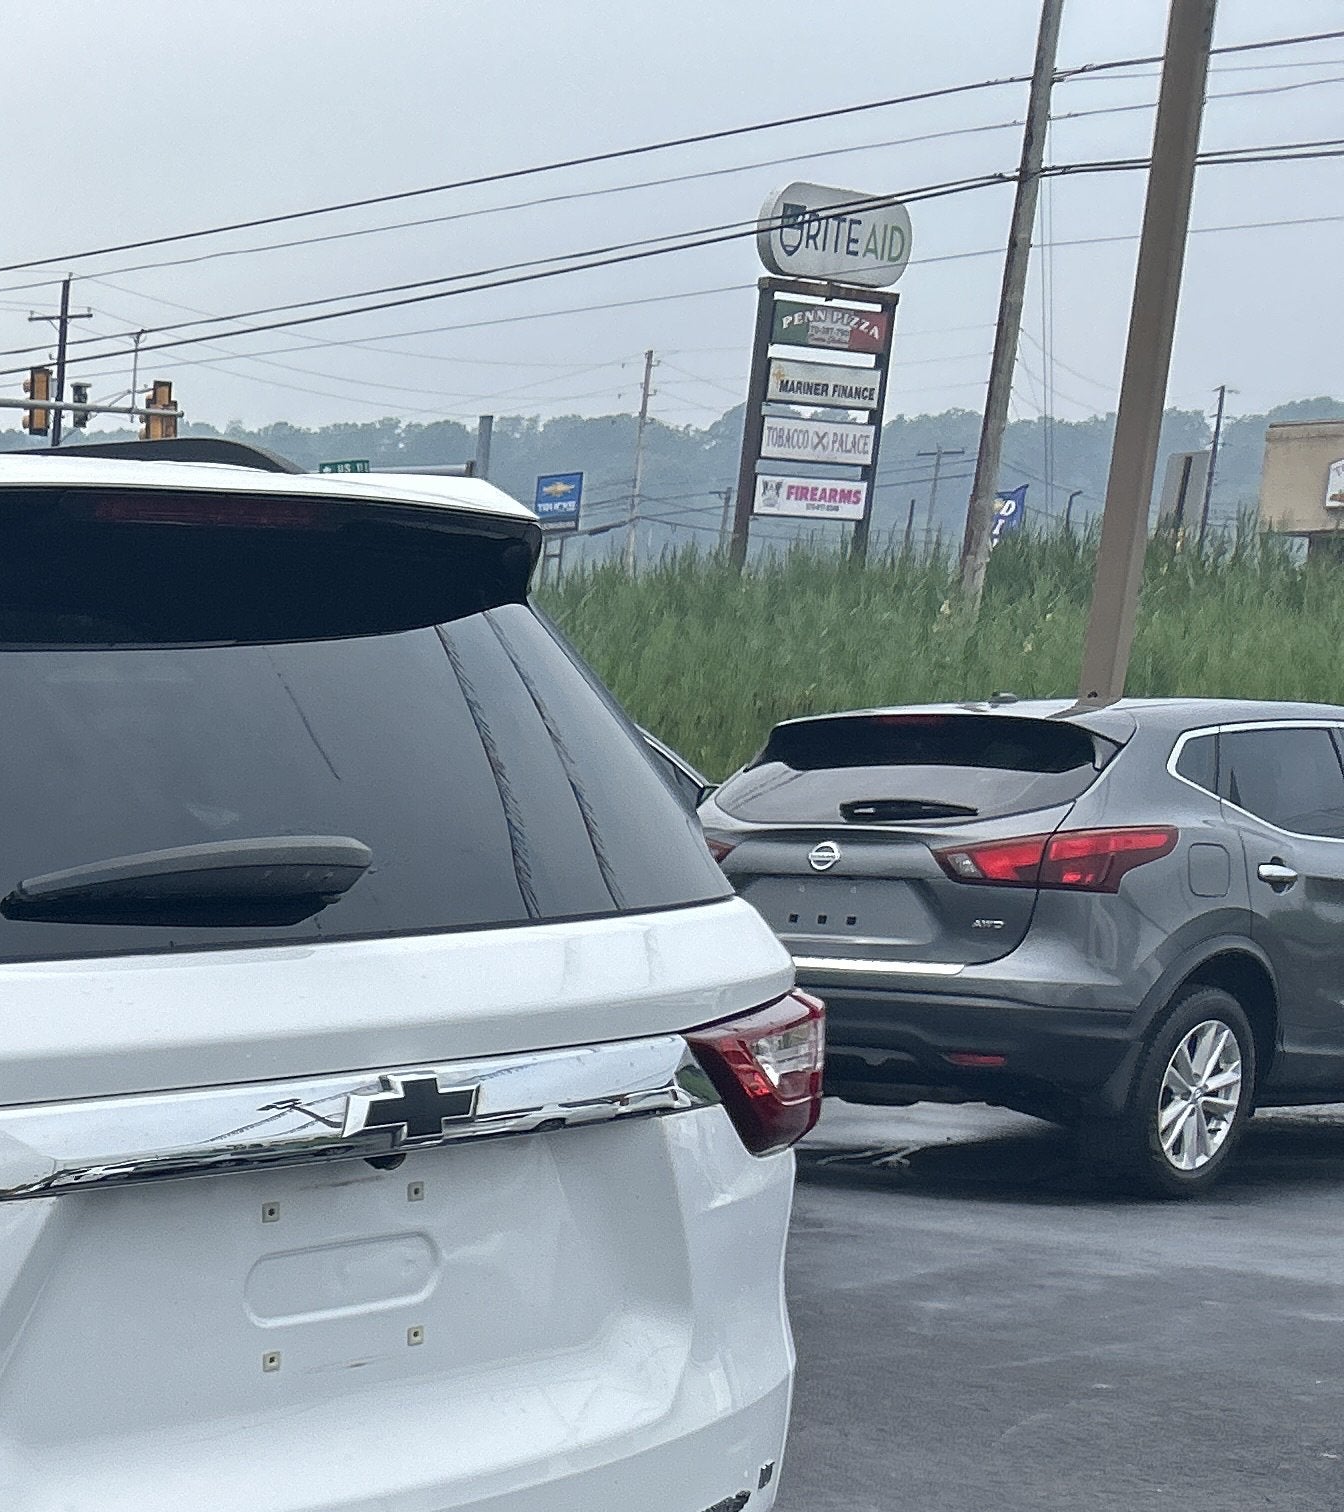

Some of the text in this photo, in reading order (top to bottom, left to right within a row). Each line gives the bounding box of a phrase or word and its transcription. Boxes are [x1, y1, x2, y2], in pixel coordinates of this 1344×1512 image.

[863, 223, 905, 262] AID
[782, 310, 827, 329] PENN
[832, 311, 880, 340] PIZZA
[779, 380, 875, 401] MARINER FINANCE
[766, 426, 870, 455] TOBACCO PALACE
[786, 484, 862, 505] FIREARMS
